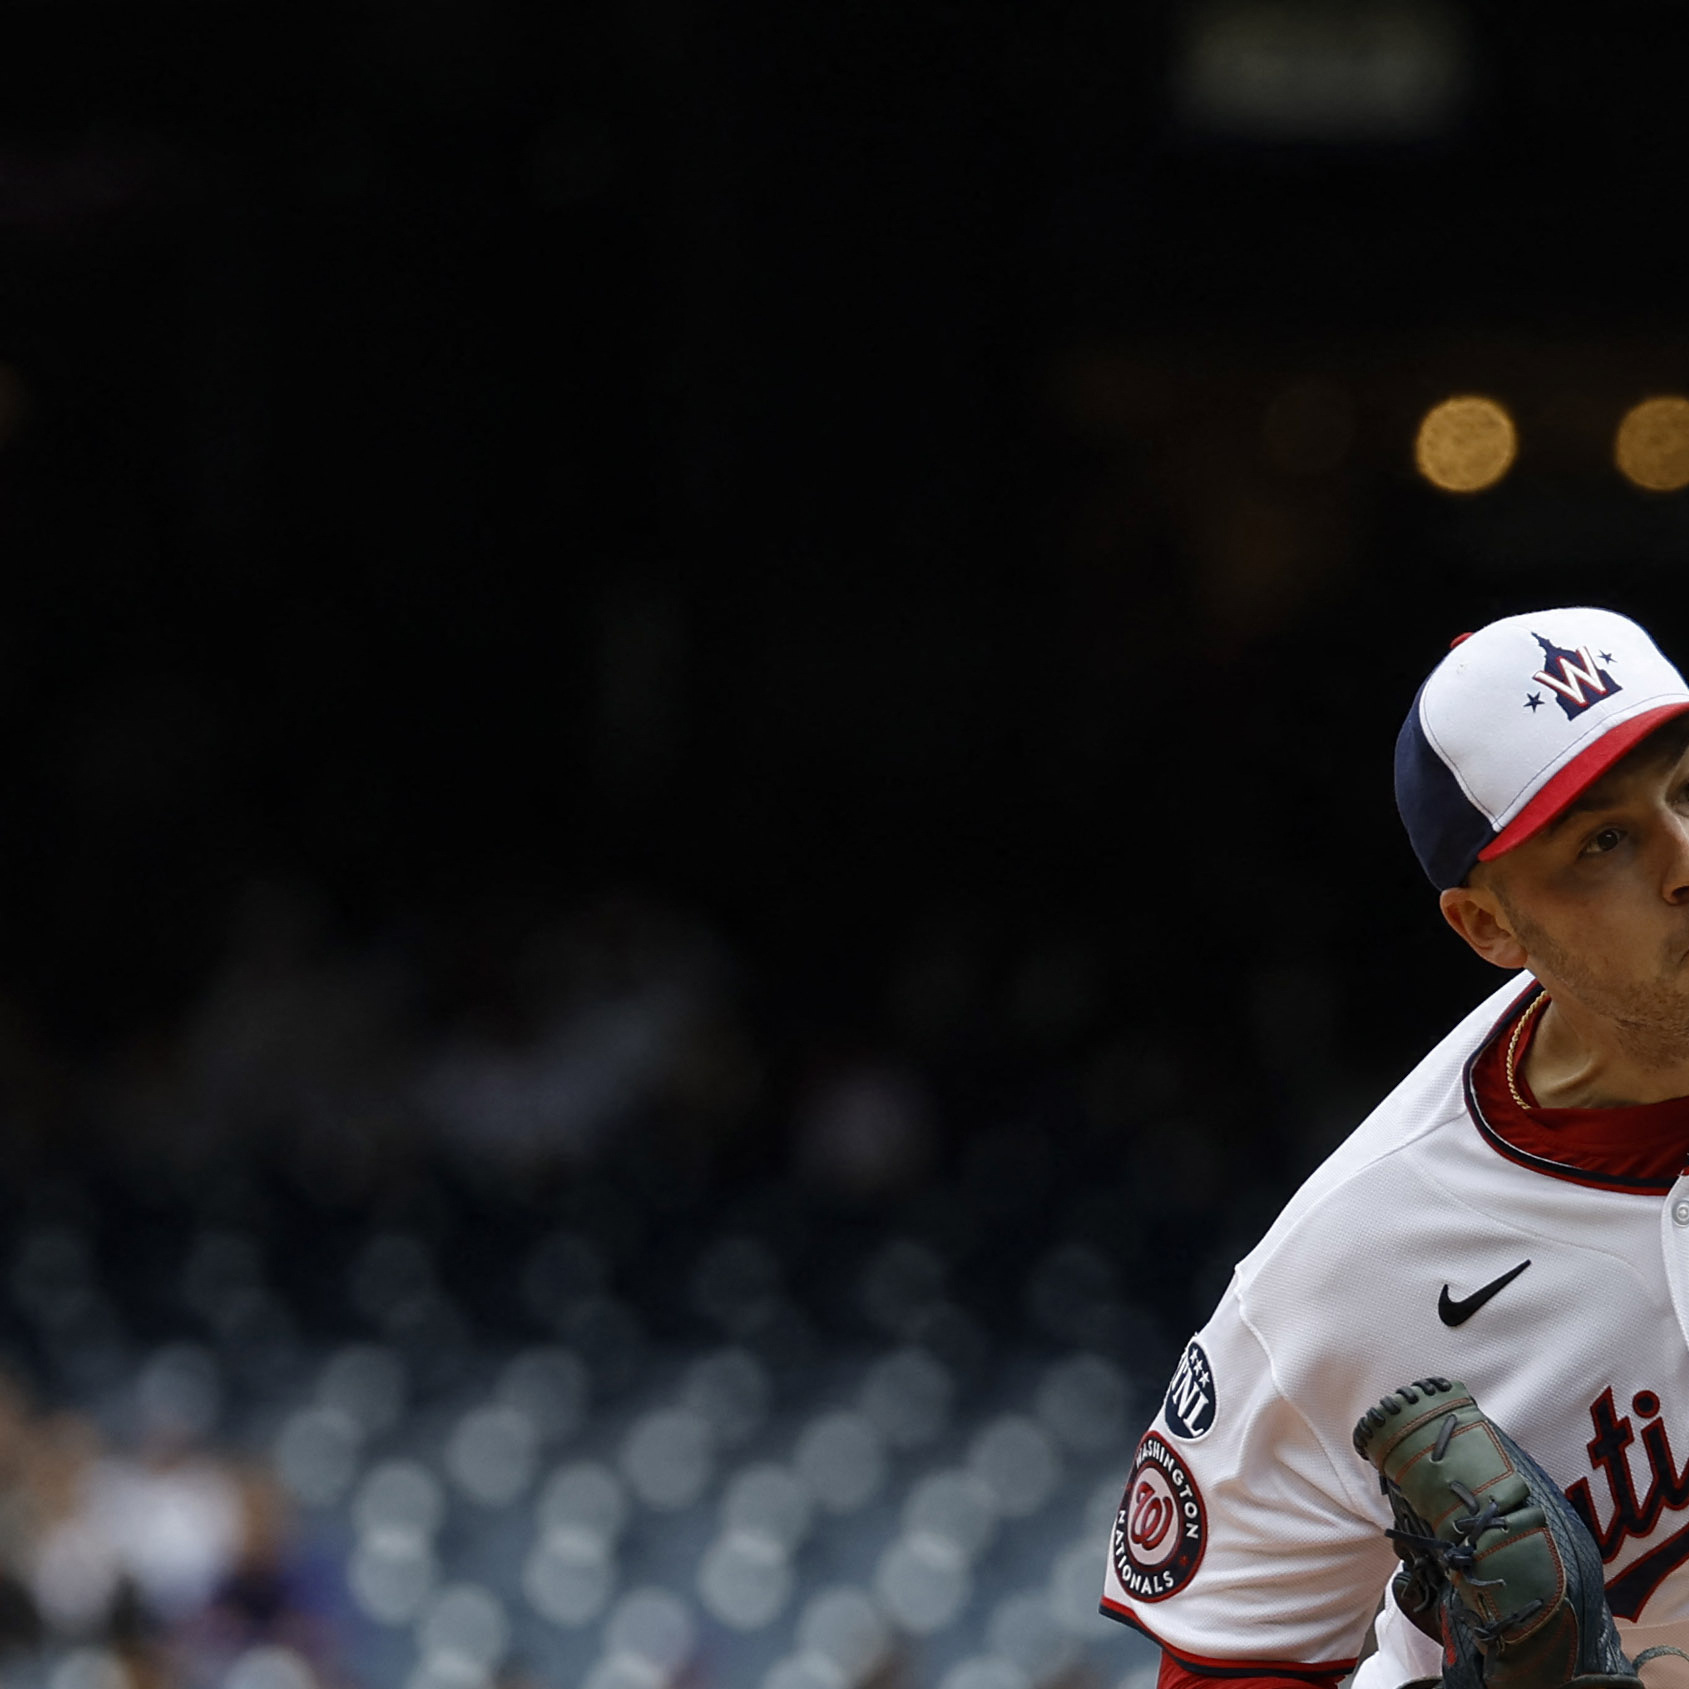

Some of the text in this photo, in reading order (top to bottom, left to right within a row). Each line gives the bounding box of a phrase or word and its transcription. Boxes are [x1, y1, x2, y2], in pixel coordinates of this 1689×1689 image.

[1532, 645, 1608, 708] W
[1131, 1481, 1173, 1551] W
[1134, 1438, 1199, 1539] WASHINGTON
[1115, 1509, 1174, 1594] NATIONALS
